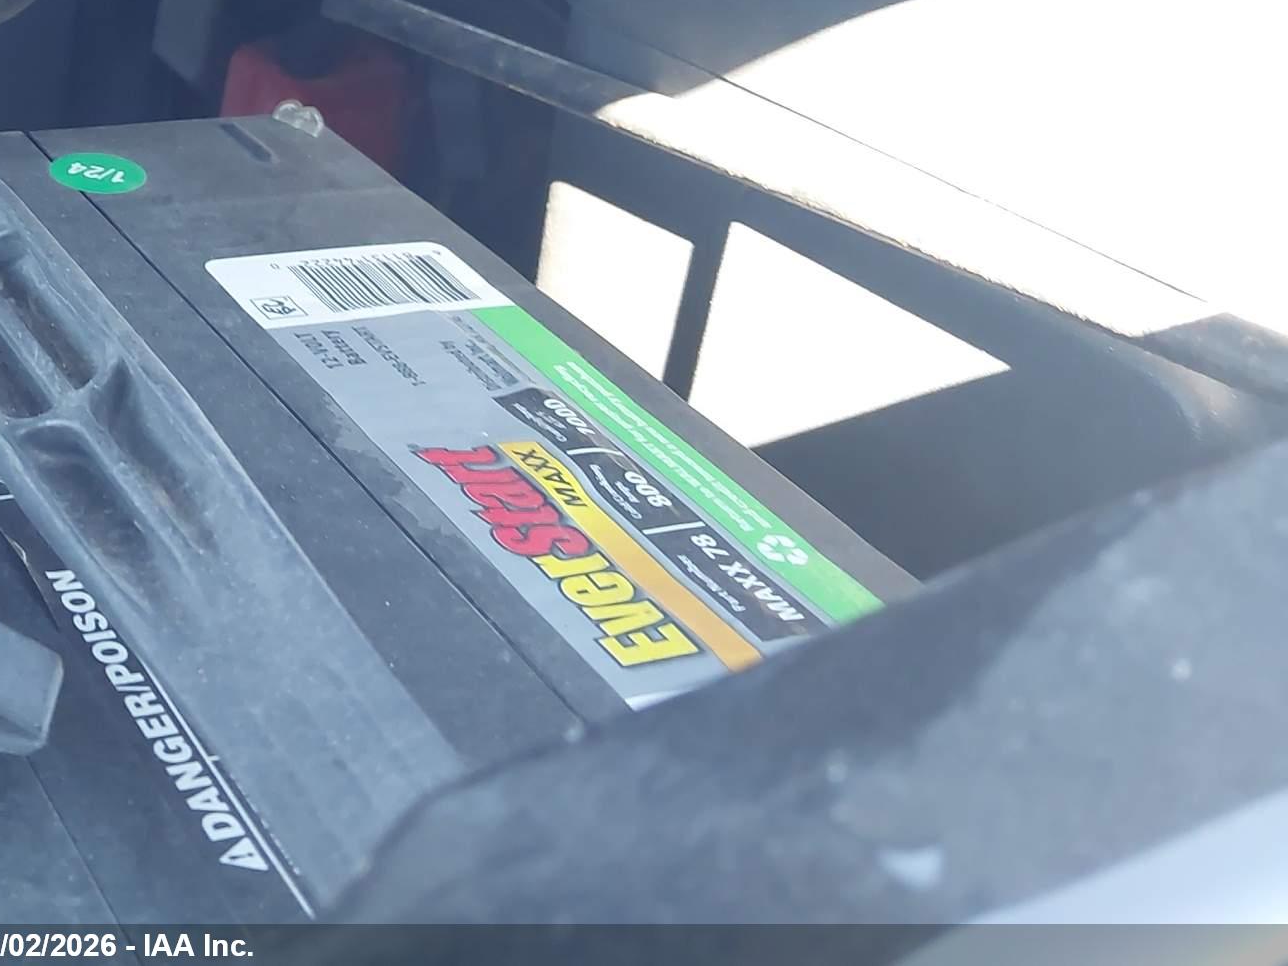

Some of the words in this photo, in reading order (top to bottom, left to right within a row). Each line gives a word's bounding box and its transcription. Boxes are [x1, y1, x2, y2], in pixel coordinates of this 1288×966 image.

[67, 161, 125, 184] 1/24
[294, 332, 344, 369] 12-VOLT
[321, 329, 367, 365] Battery
[543, 398, 596, 435] 1000
[512, 449, 588, 507] MAXX
[624, 471, 672, 507] 800
[412, 445, 702, 667] EverStart
[690, 534, 730, 560] 78
[718, 561, 805, 621] MAXX
[45, 569, 248, 842] DANGER/POISON
